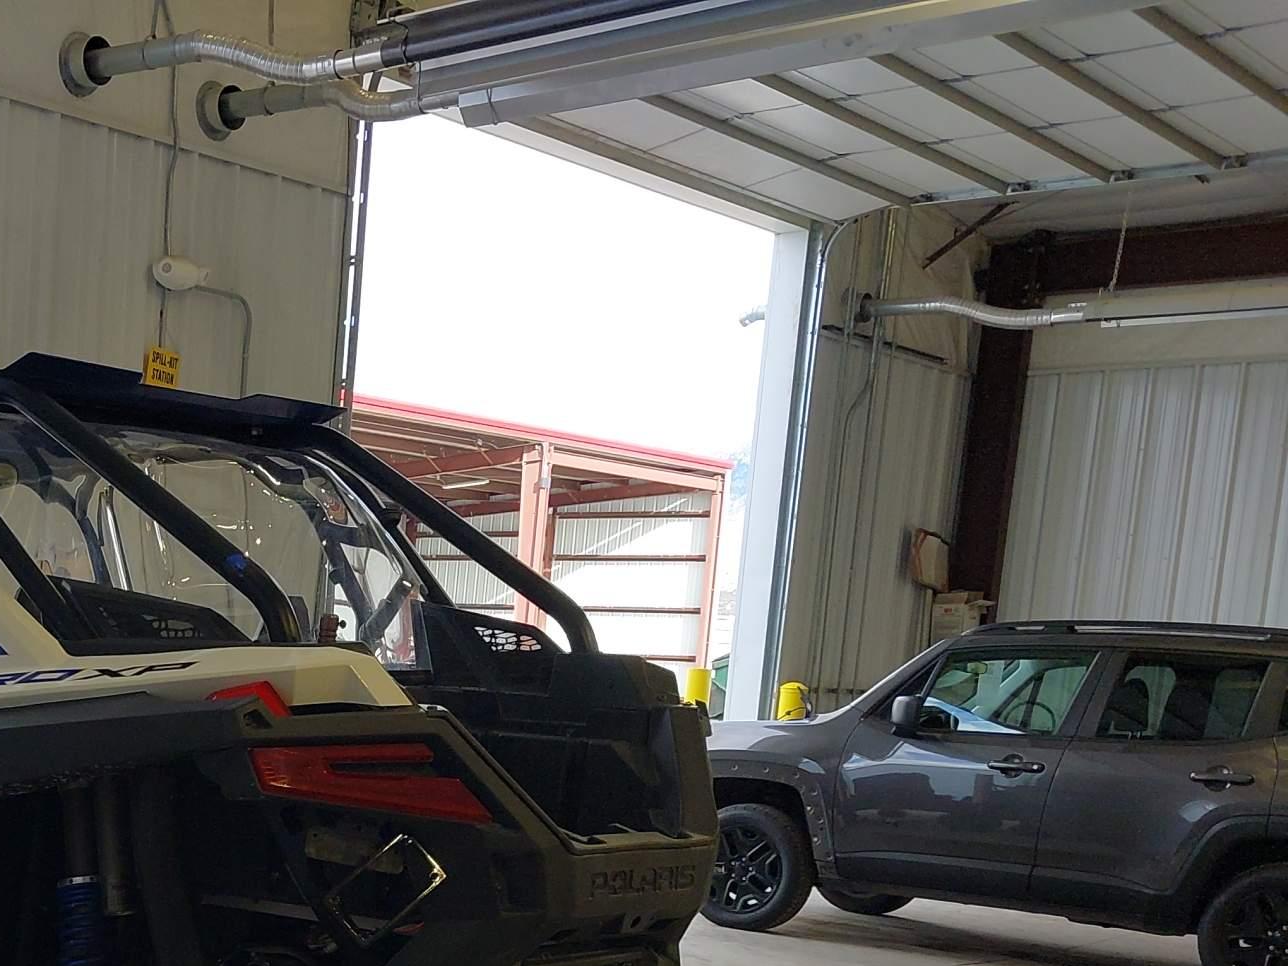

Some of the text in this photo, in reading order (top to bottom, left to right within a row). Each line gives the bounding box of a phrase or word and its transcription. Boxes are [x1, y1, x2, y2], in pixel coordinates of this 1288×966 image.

[152, 351, 179, 370] SPILL-KIT
[151, 367, 175, 385] STATION
[589, 865, 696, 898] POLARIS
